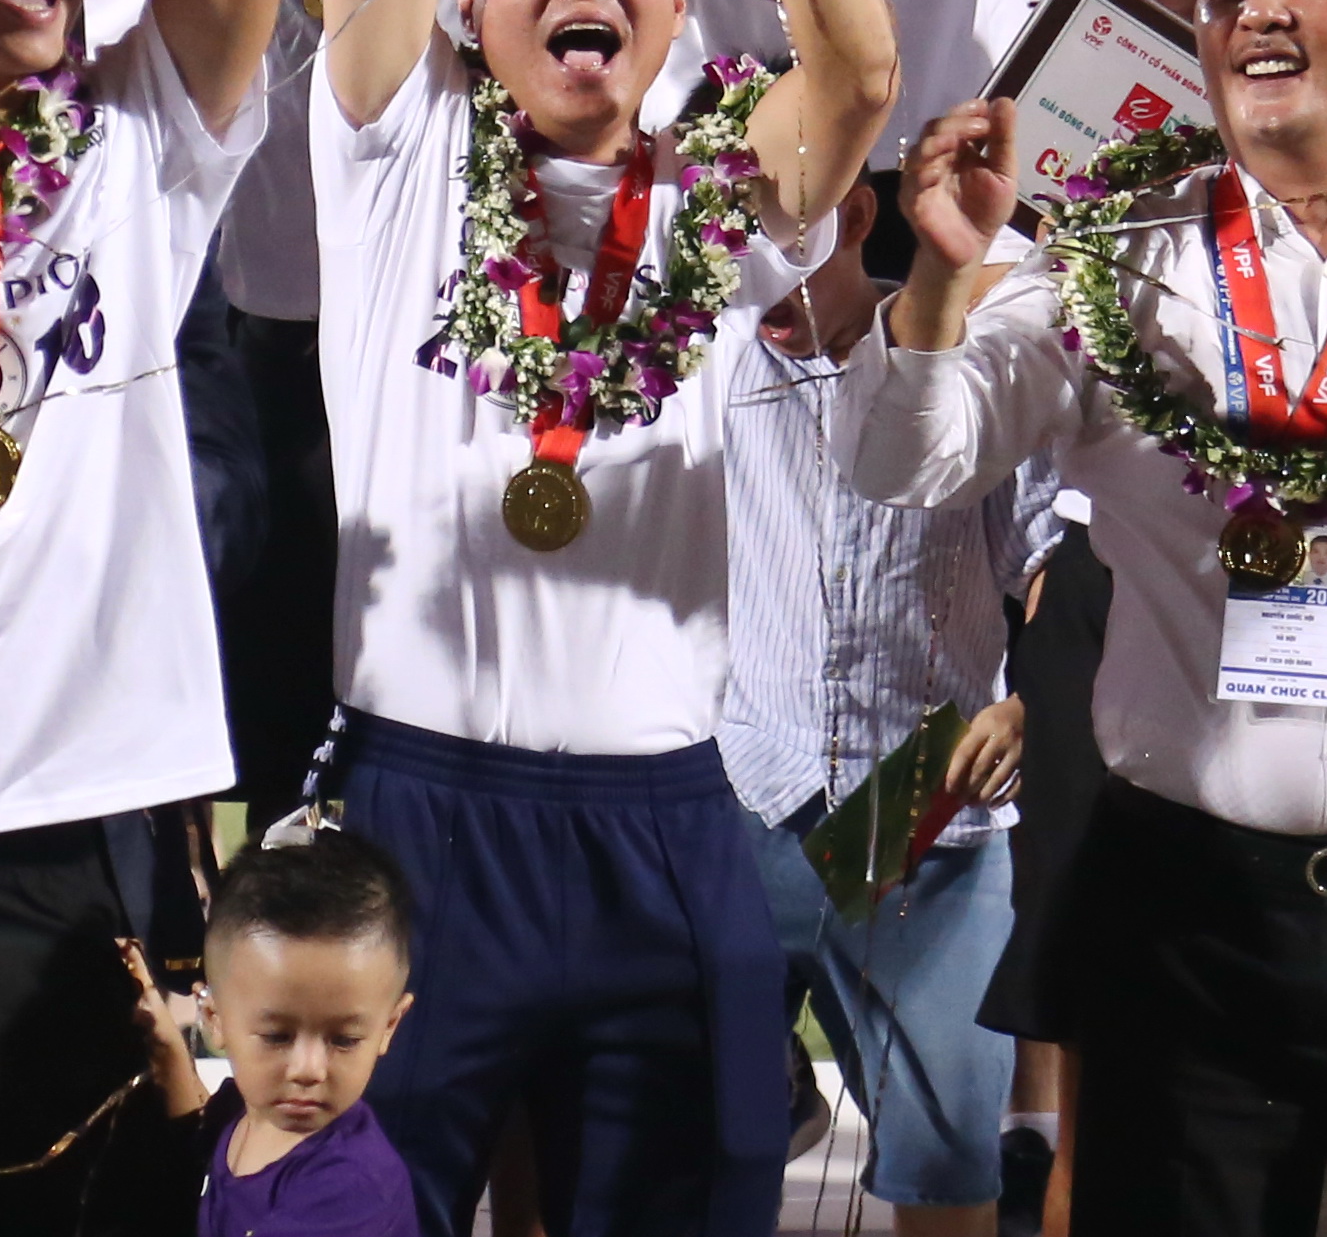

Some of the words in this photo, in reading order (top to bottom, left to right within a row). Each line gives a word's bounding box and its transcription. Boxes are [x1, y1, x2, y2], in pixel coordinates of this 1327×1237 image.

[1084, 31, 1105, 48] VPF
[1138, 48, 1150, 62] TY
[1232, 240, 1254, 279] VPF
[1255, 355, 1278, 396] VPF
[1226, 682, 1266, 695] QUAN
